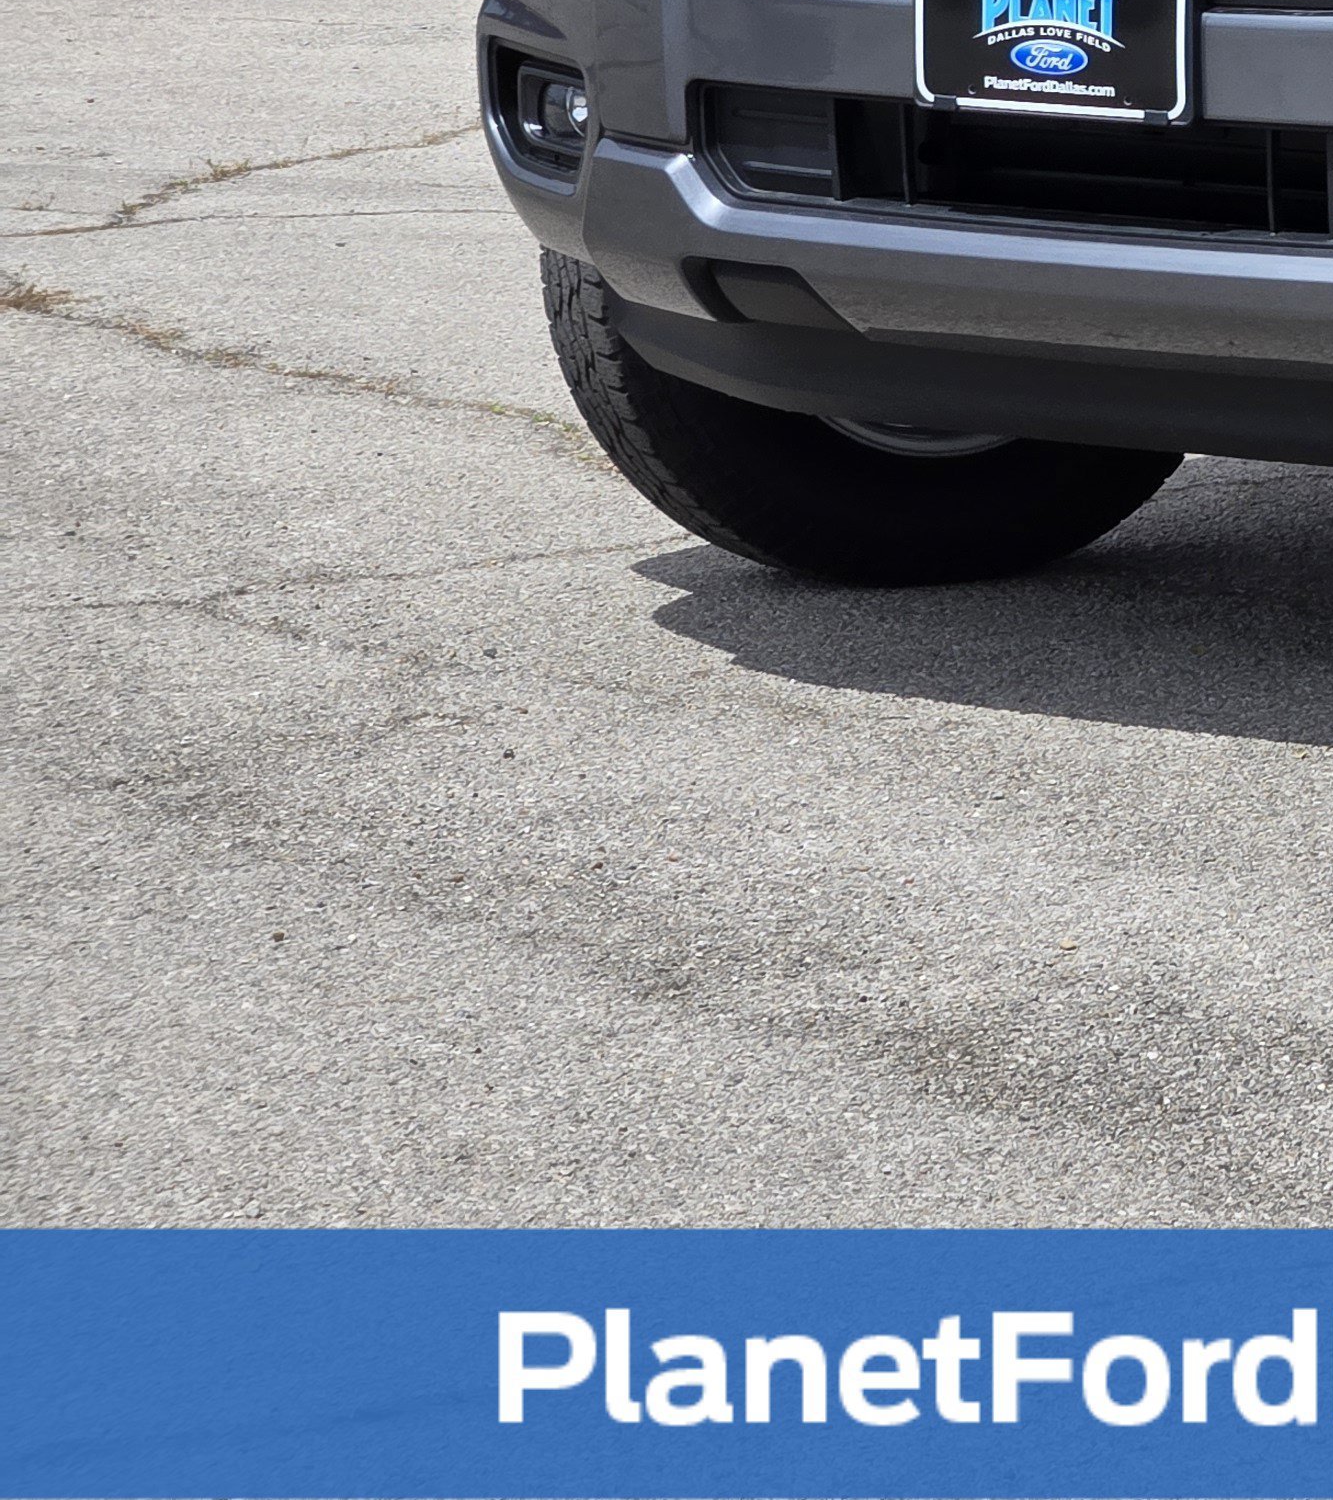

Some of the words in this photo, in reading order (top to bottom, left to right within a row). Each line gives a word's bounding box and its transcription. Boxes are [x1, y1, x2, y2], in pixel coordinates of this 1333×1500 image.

[987, 27, 1036, 46] DALLAS
[1039, 27, 1073, 39] LOVE
[1075, 33, 1112, 53] FIELD
[1025, 44, 1074, 71] Ford
[983, 75, 1116, 98] PlanetFordDallas.com
